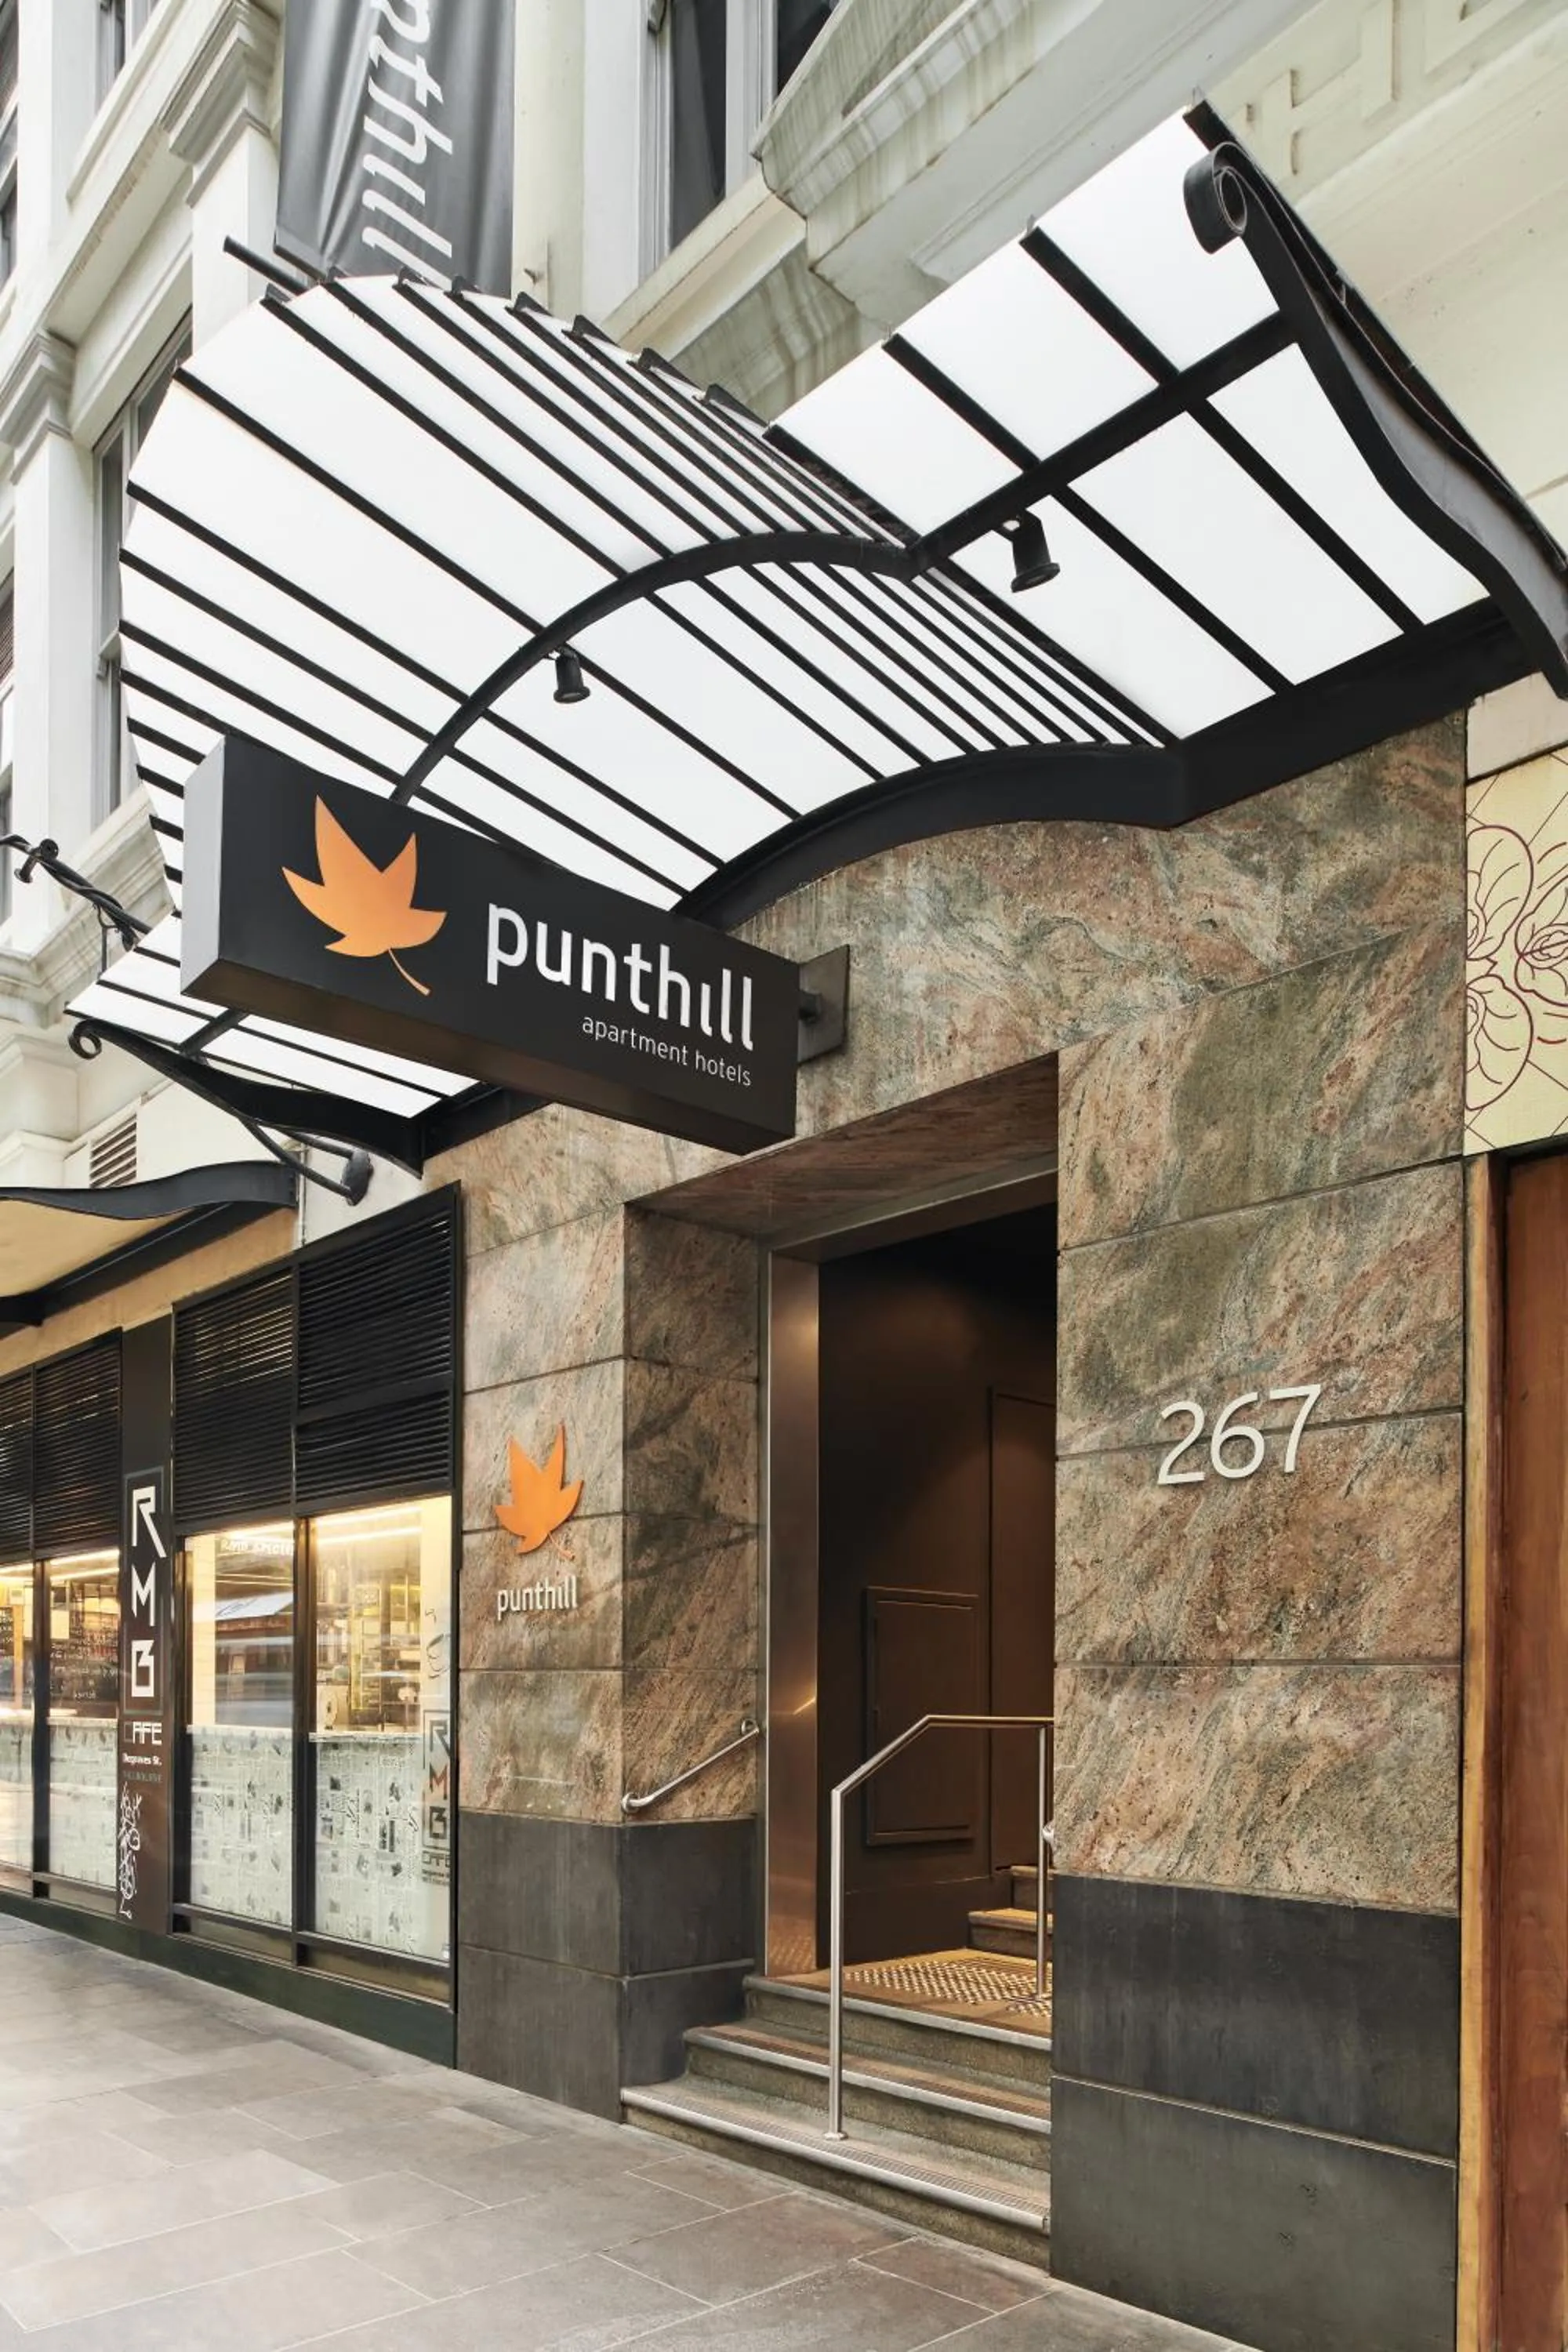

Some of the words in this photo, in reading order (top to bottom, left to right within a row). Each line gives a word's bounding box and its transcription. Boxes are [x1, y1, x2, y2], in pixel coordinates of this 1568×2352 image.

[486, 902, 753, 1051] punthill
[582, 1016, 688, 1067] apartment
[695, 1050, 753, 1087] hotels
[1157, 1384, 1322, 1485] 267
[497, 1574, 578, 1621] punthill
